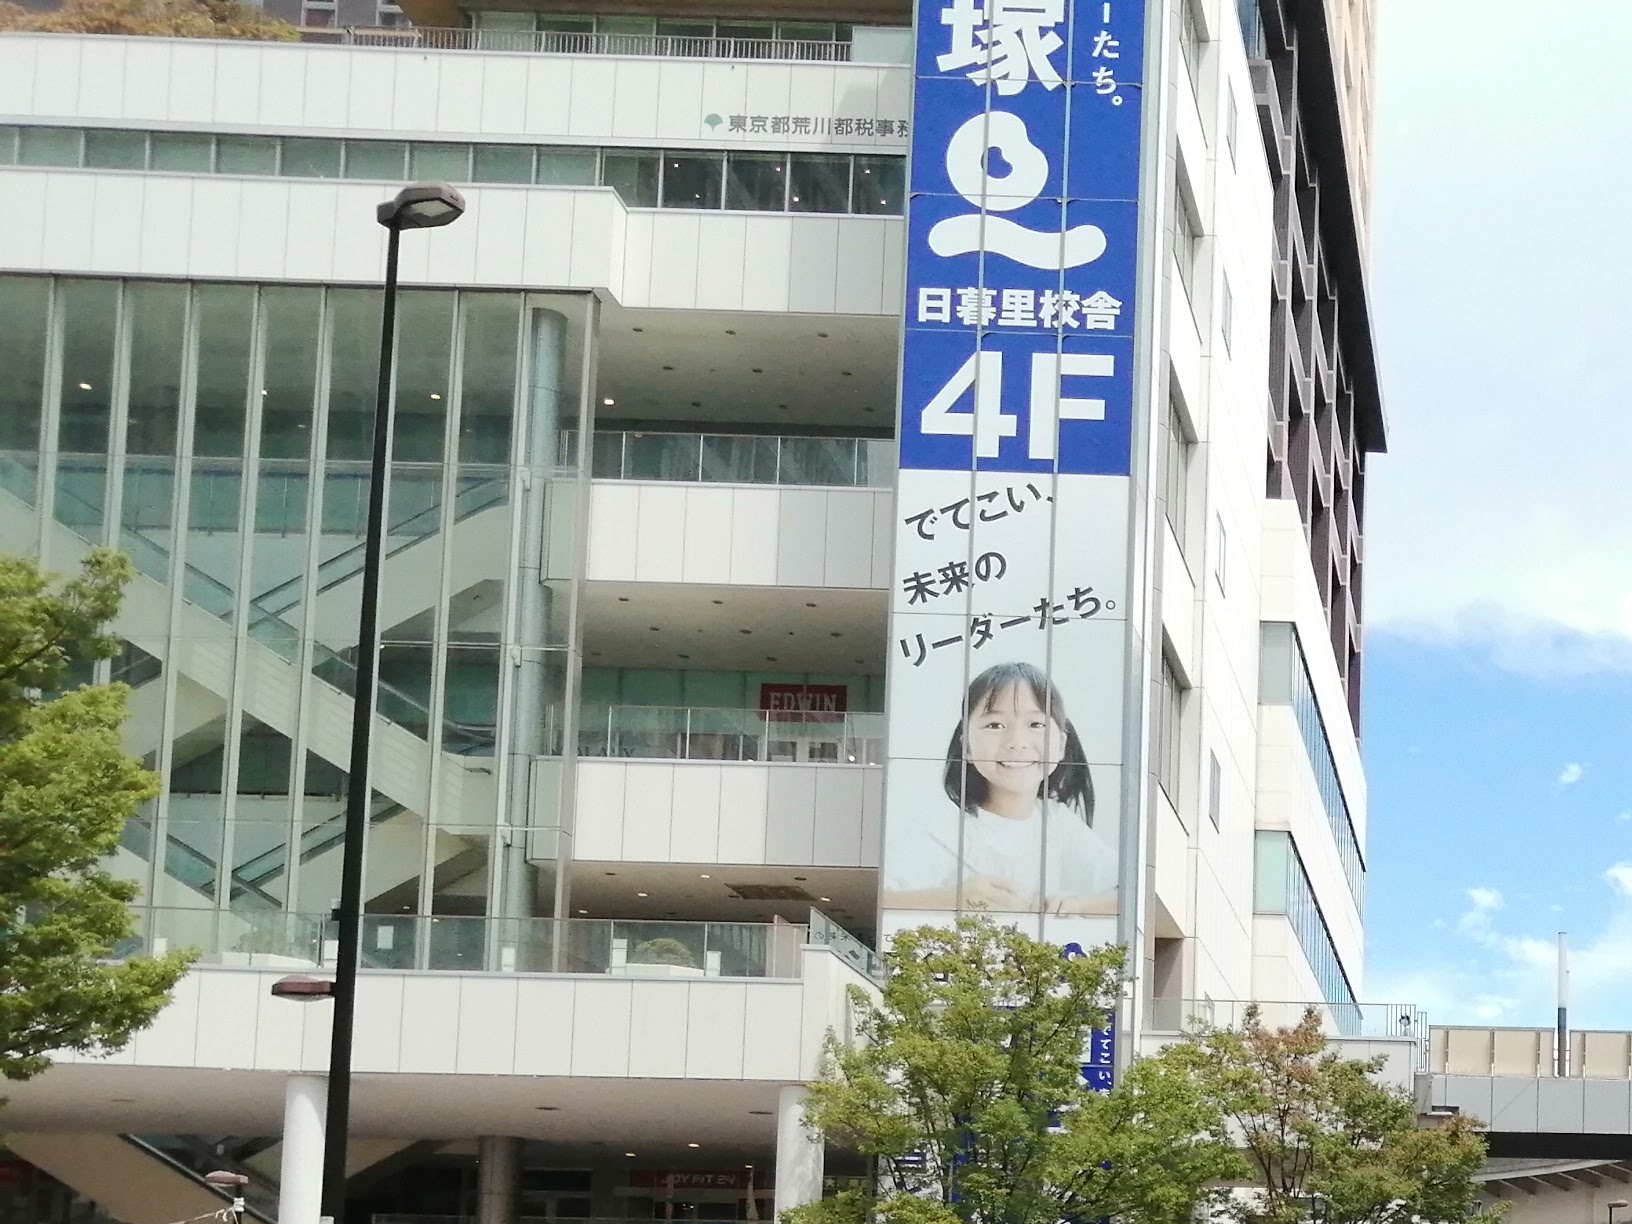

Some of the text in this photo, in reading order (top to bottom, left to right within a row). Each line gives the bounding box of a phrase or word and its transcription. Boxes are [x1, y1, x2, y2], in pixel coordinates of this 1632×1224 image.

[917, 287, 1122, 330] 日暮里校舎
[920, 351, 1114, 460] 4F
[904, 482, 1053, 540] でてこい、
[903, 551, 1007, 606] 未来の
[900, 586, 1116, 667] リーダーたち。
[769, 691, 837, 713] EDWIN
